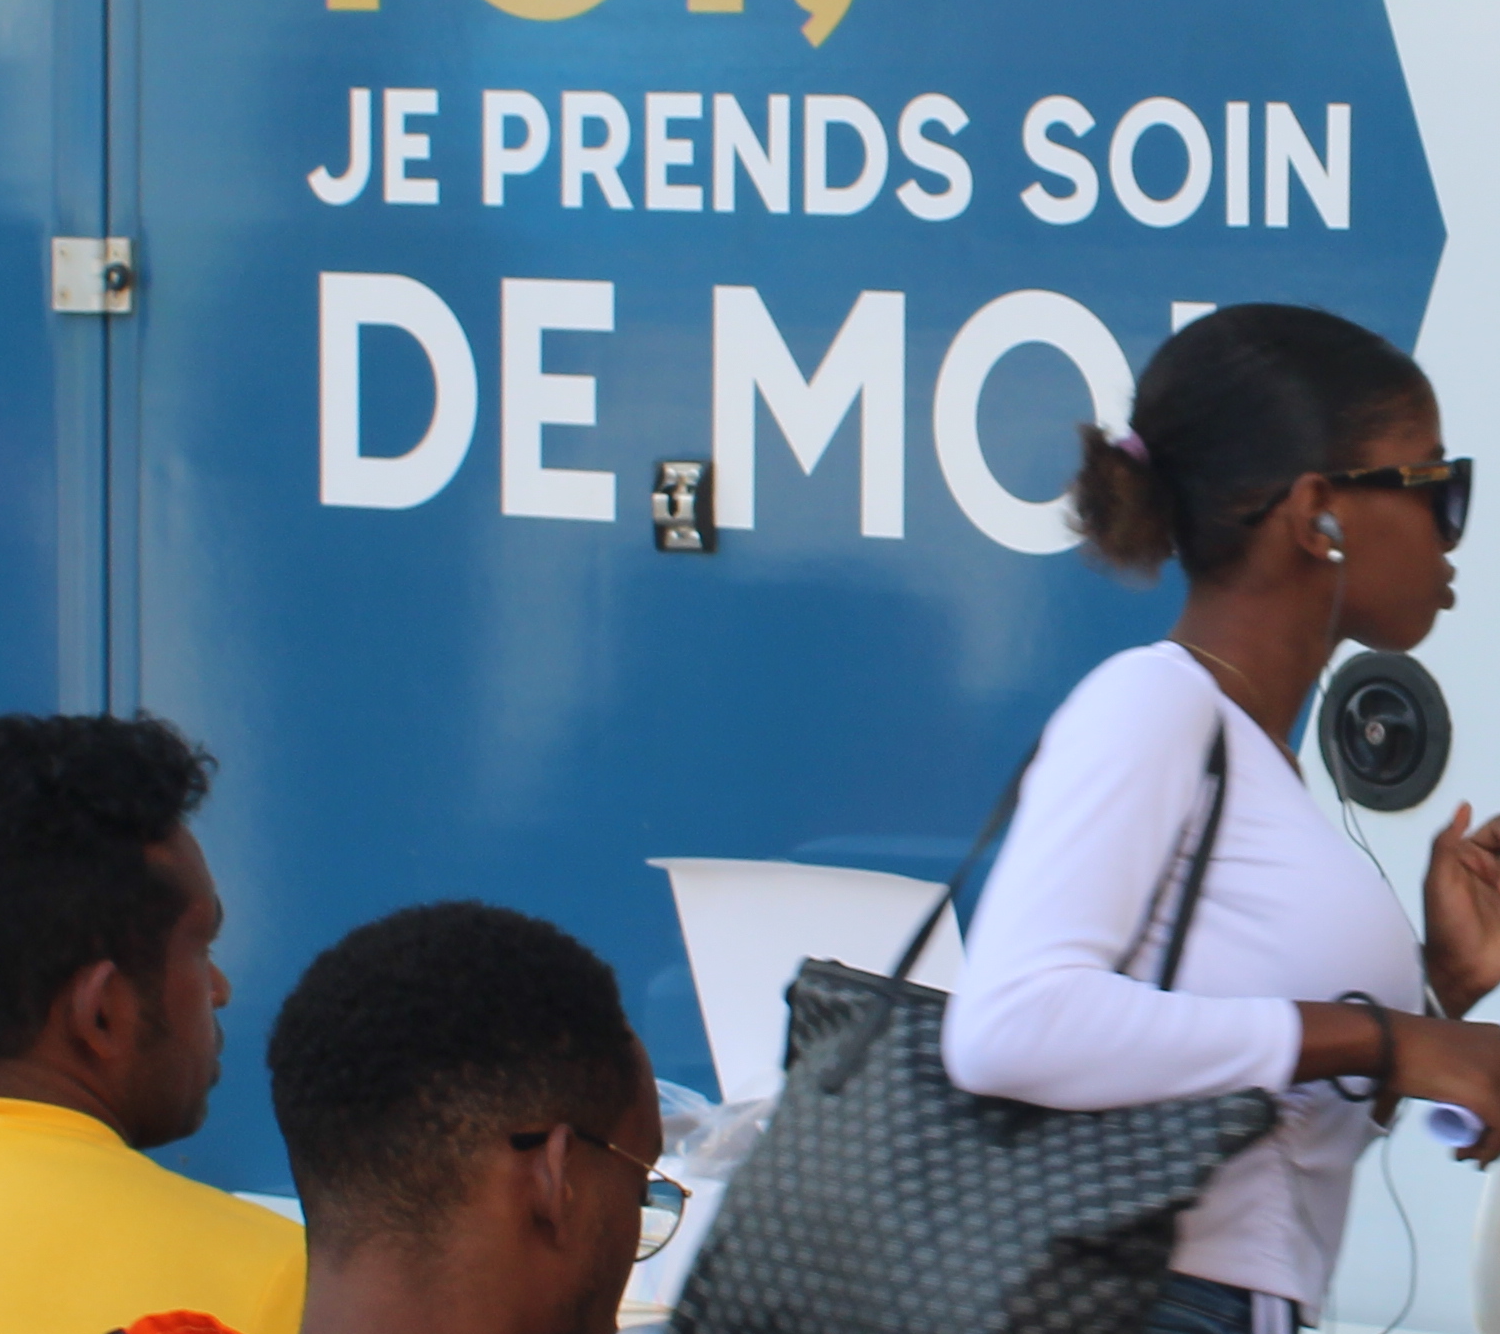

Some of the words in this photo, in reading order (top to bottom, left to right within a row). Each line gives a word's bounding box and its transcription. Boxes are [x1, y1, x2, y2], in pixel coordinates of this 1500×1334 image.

[307, 88, 441, 206] JE
[481, 90, 974, 222] PRENDS
[1019, 94, 1353, 231] SOIN
[318, 272, 617, 524] DE
[713, 284, 1217, 556] MO
